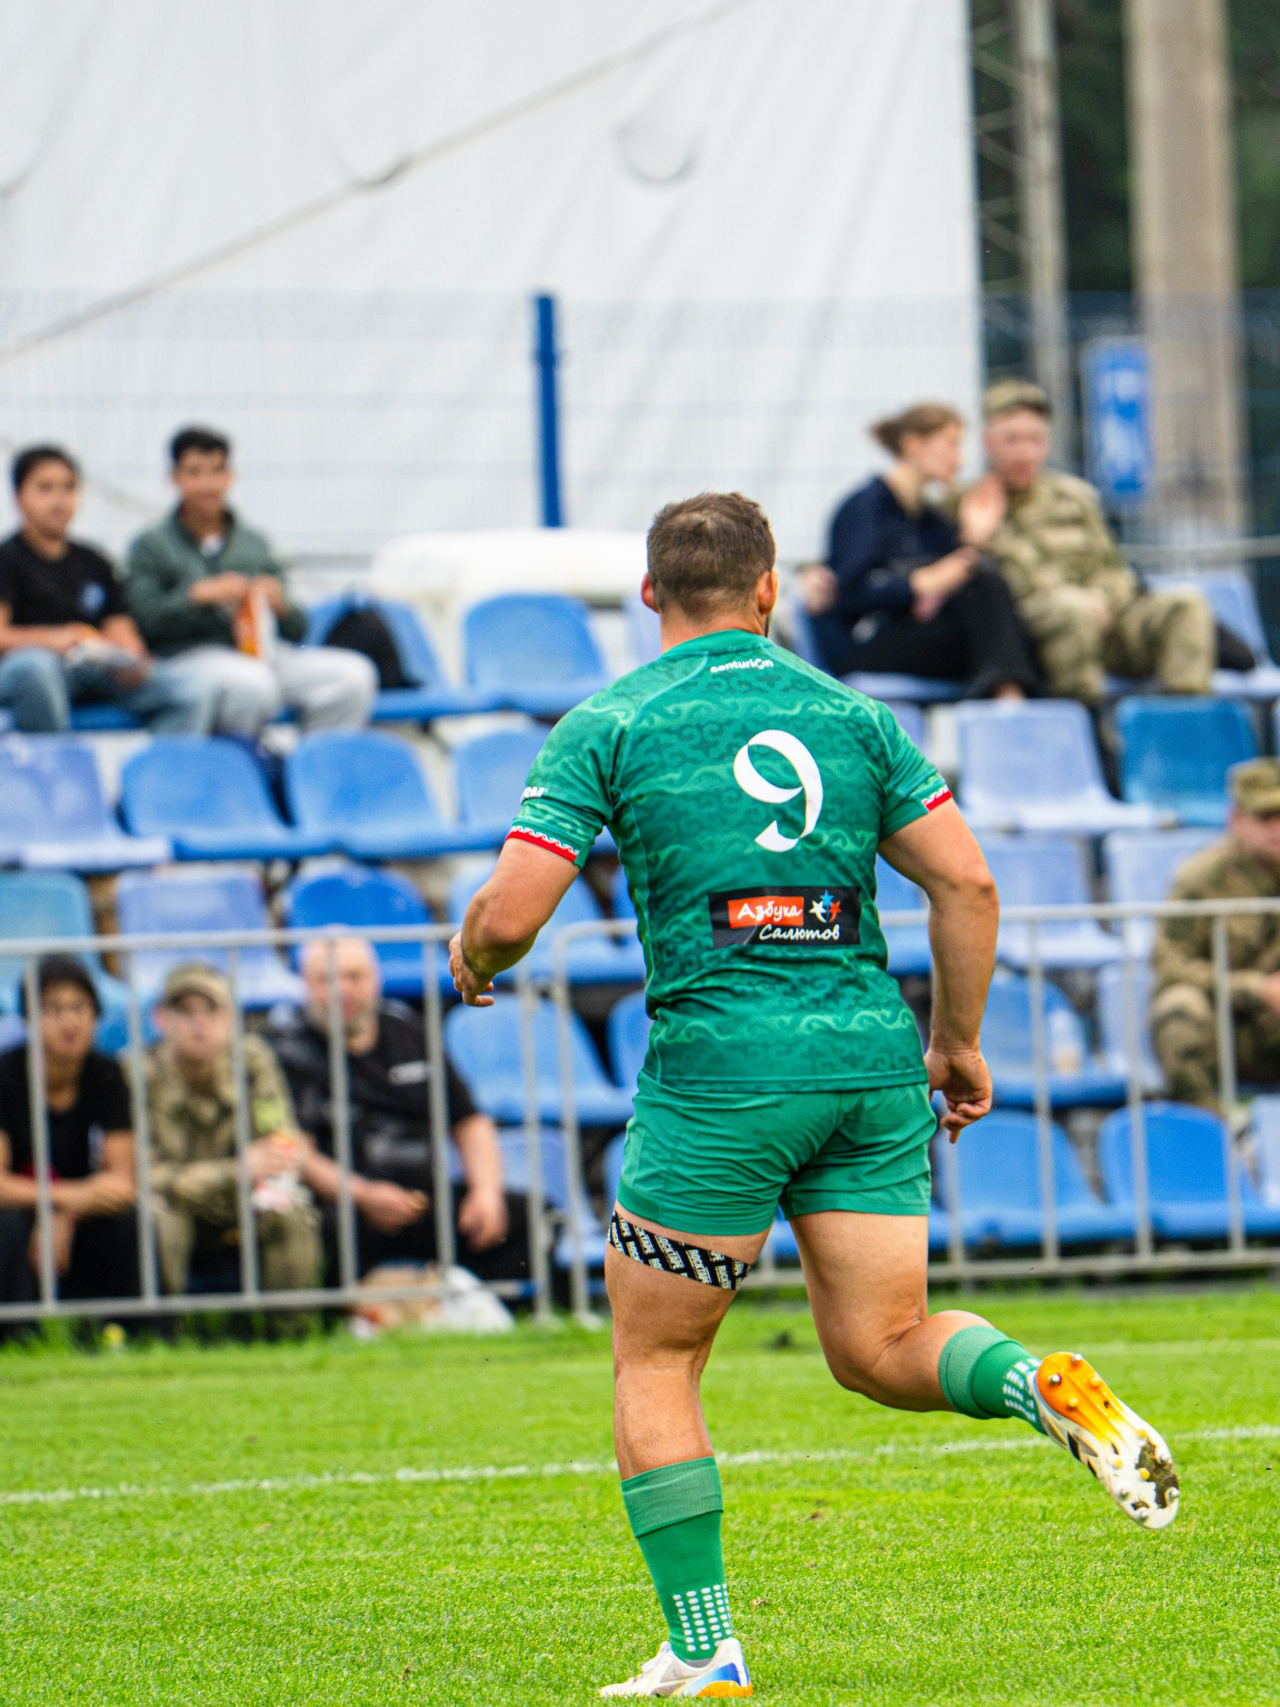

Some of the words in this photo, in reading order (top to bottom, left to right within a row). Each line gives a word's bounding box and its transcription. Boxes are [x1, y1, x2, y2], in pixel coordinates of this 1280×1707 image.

[733, 729, 824, 852] 9
[737, 900, 803, 922] Азбука
[759, 923, 841, 941] Салютов
